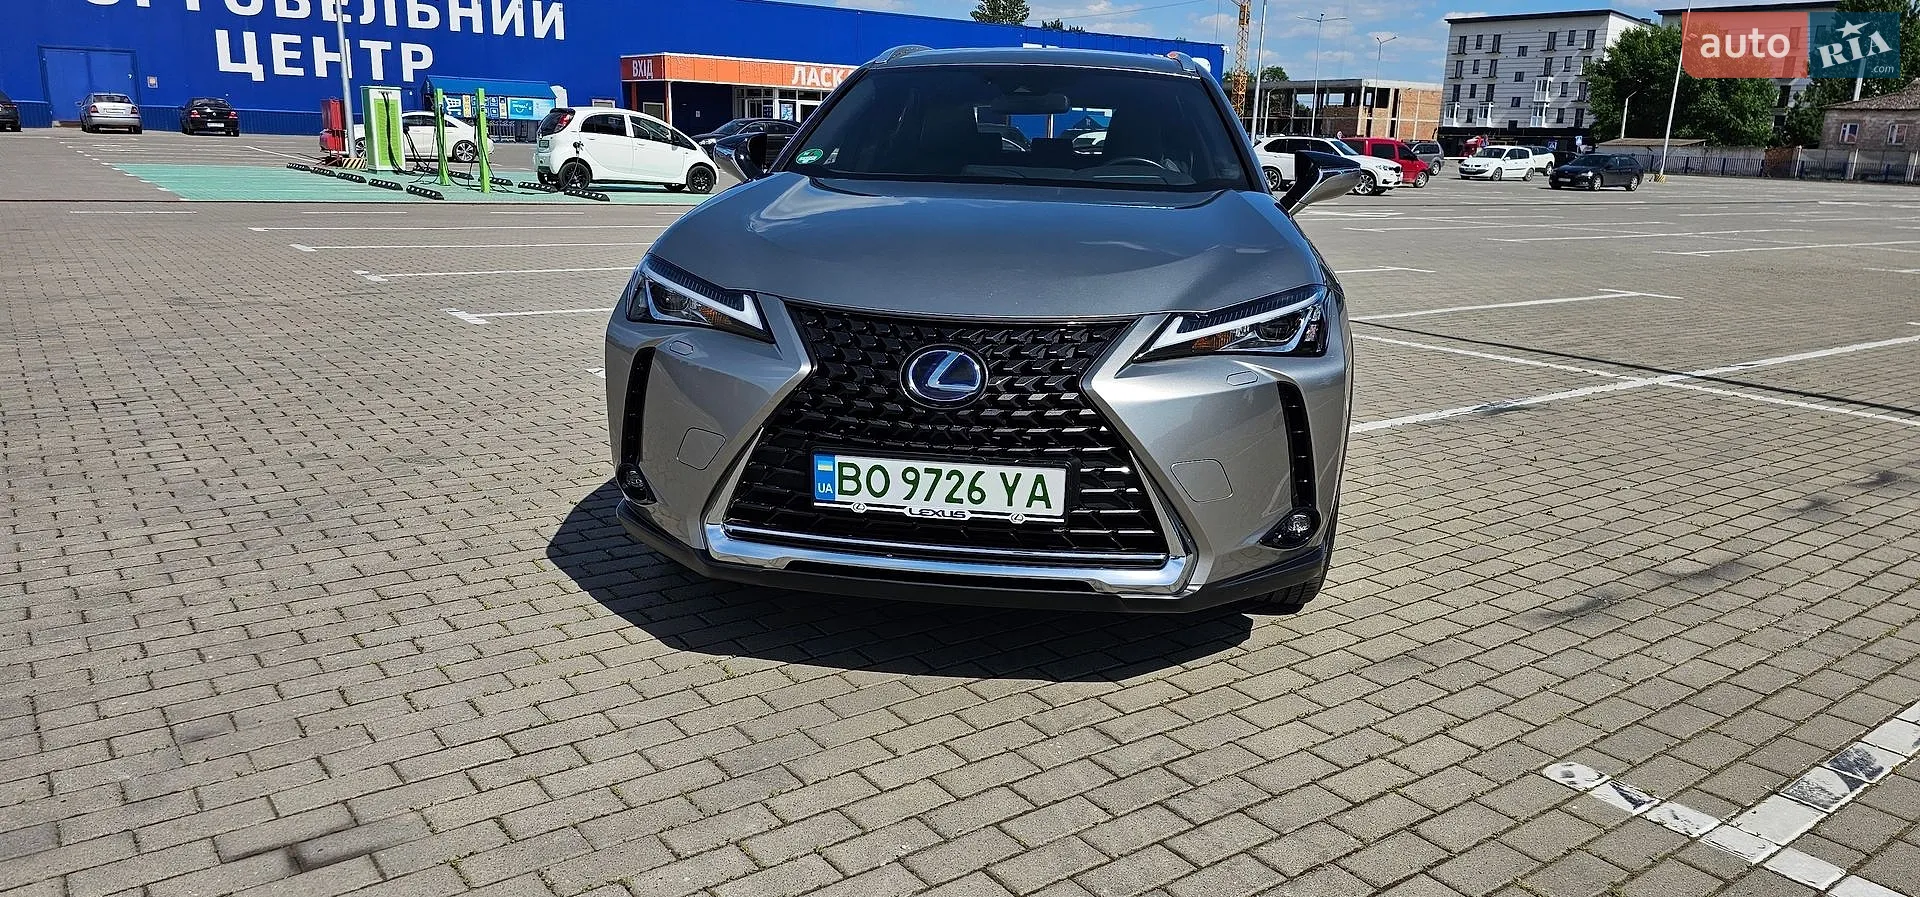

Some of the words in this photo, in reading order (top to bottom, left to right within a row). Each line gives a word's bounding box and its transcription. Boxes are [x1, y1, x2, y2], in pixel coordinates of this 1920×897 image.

[215, 29, 434, 82] ЦЕНТР
[632, 60, 654, 80] ВХІД
[791, 66, 856, 88] ЛАСК
[817, 483, 834, 494] UA
[838, 462, 891, 499] BO
[901, 466, 987, 506] 9726
[1000, 472, 1053, 509] YA
[908, 507, 968, 519] LEXUS
